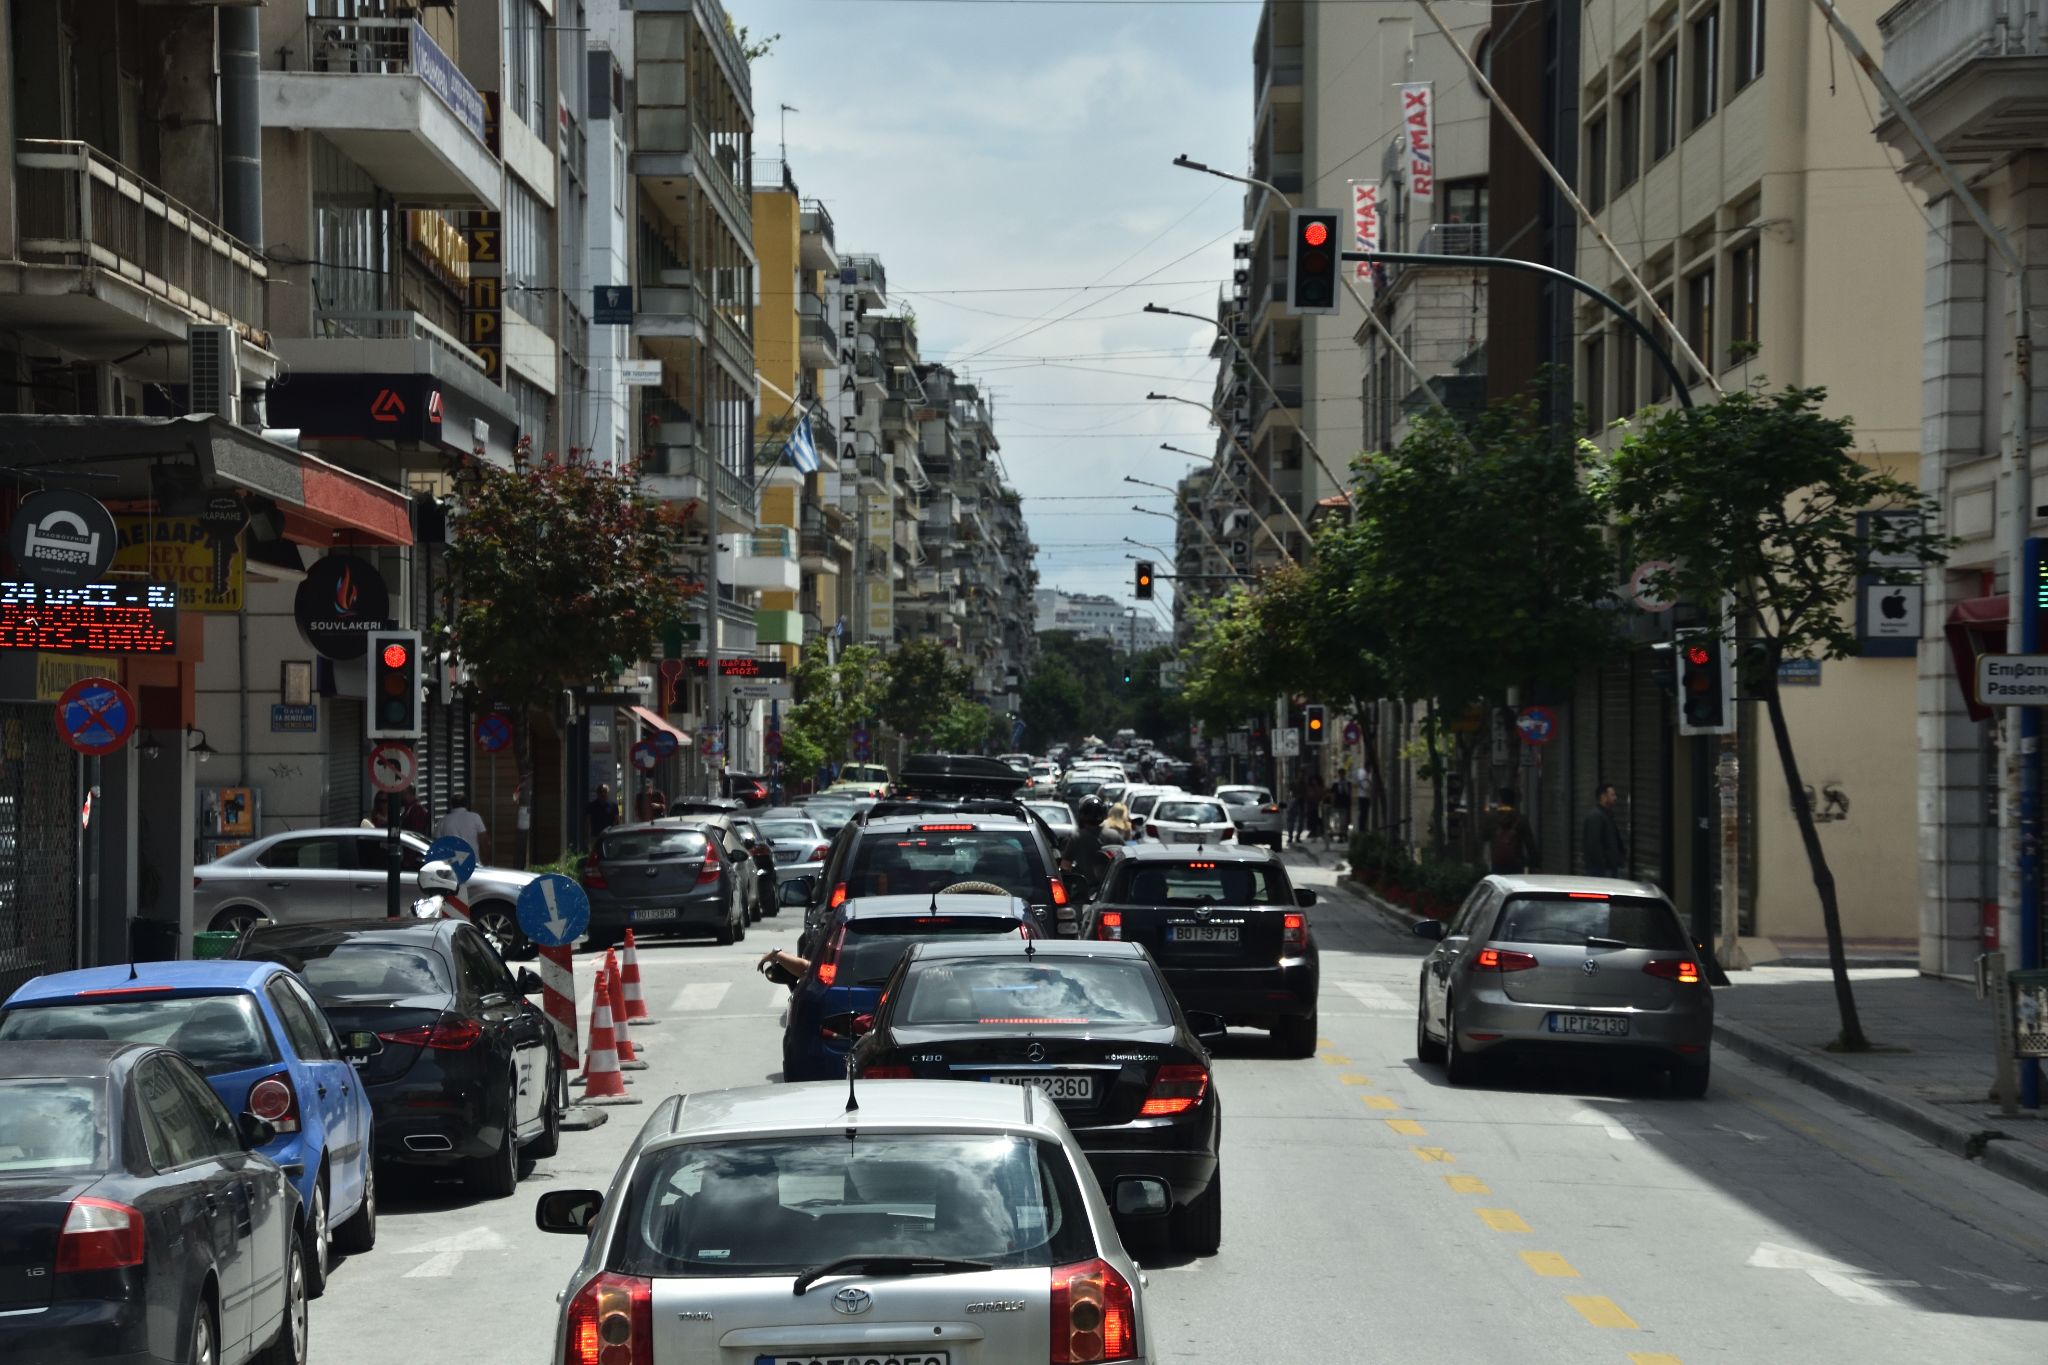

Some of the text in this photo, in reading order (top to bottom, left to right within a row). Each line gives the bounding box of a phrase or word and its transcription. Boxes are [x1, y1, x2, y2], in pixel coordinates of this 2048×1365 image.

[1405, 91, 1432, 195] RE/MAX
[1356, 186, 1376, 277] R/MAX
[1234, 243, 1249, 363] HOTEL
[147, 546, 187, 563] KEY
[311, 621, 381, 631] SOUVLAKERI
[1988, 682, 2048, 696] Passen
[1105, 1053, 1159, 1061] KOMPRESSOR
[1042, 1078, 1089, 1097] 2360
[965, 1300, 1025, 1314] COROLLA
[678, 1311, 713, 1321] TOYOTA
